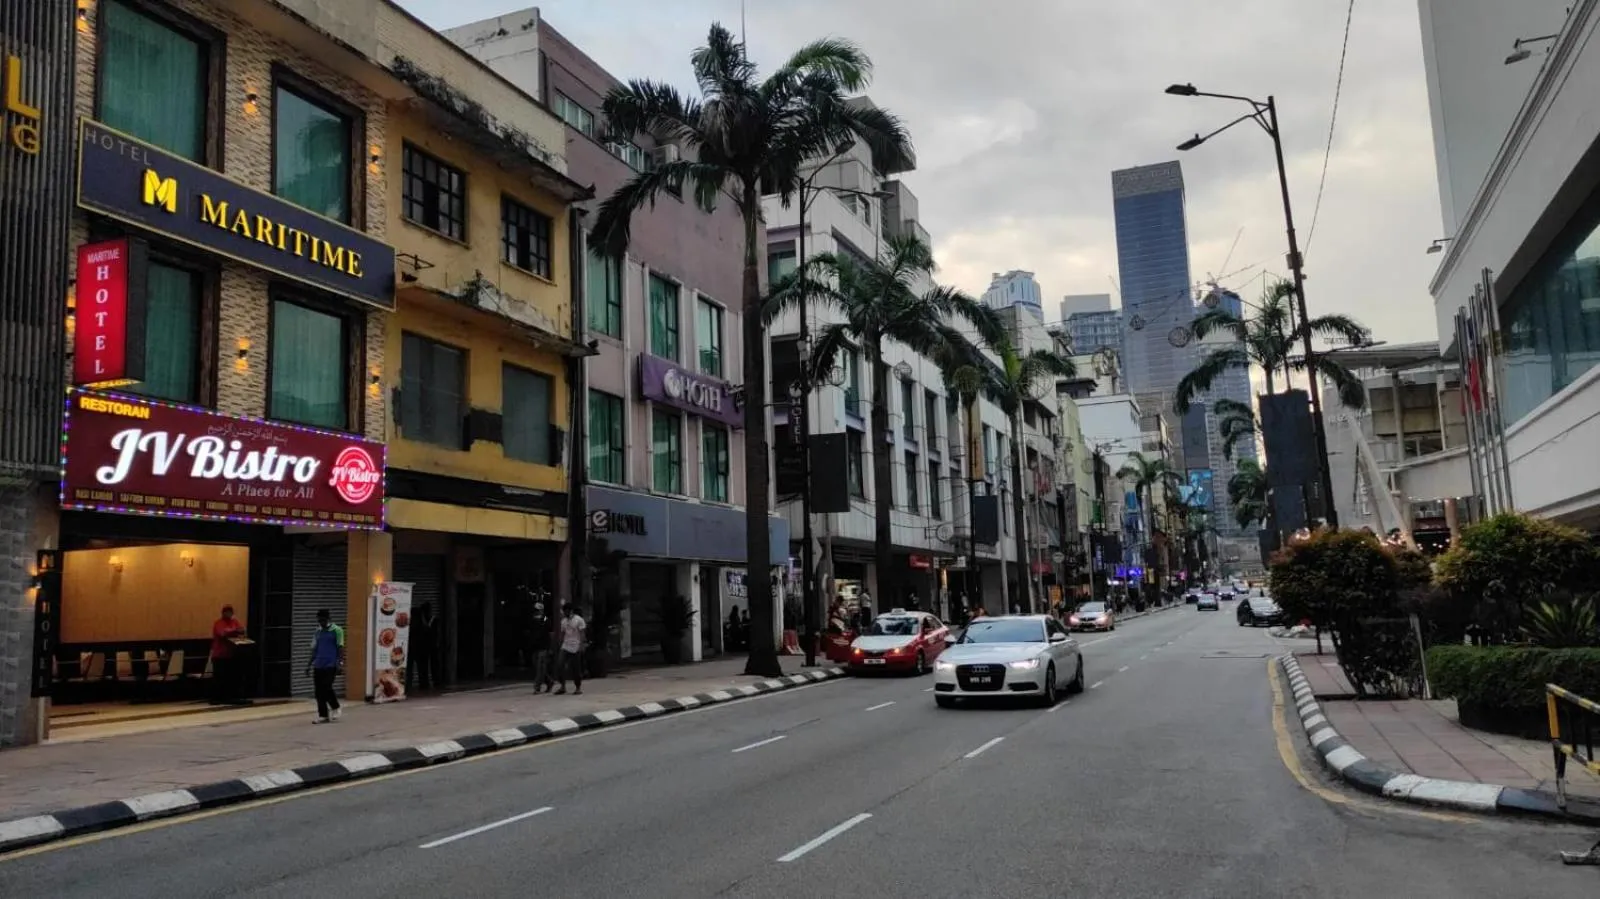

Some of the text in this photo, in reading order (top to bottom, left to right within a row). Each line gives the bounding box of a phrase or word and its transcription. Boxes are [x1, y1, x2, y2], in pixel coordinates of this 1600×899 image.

[85, 127, 152, 166] HOTEL
[200, 193, 364, 278] MARITIME
[87, 248, 121, 264] MARITIME
[94, 264, 110, 375] HOTEL
[80, 396, 150, 419] RESTORAN
[96, 428, 320, 484] JV Bistro
[221, 483, 314, 498] A Place for All
[329, 466, 380, 486] JV Bistro
